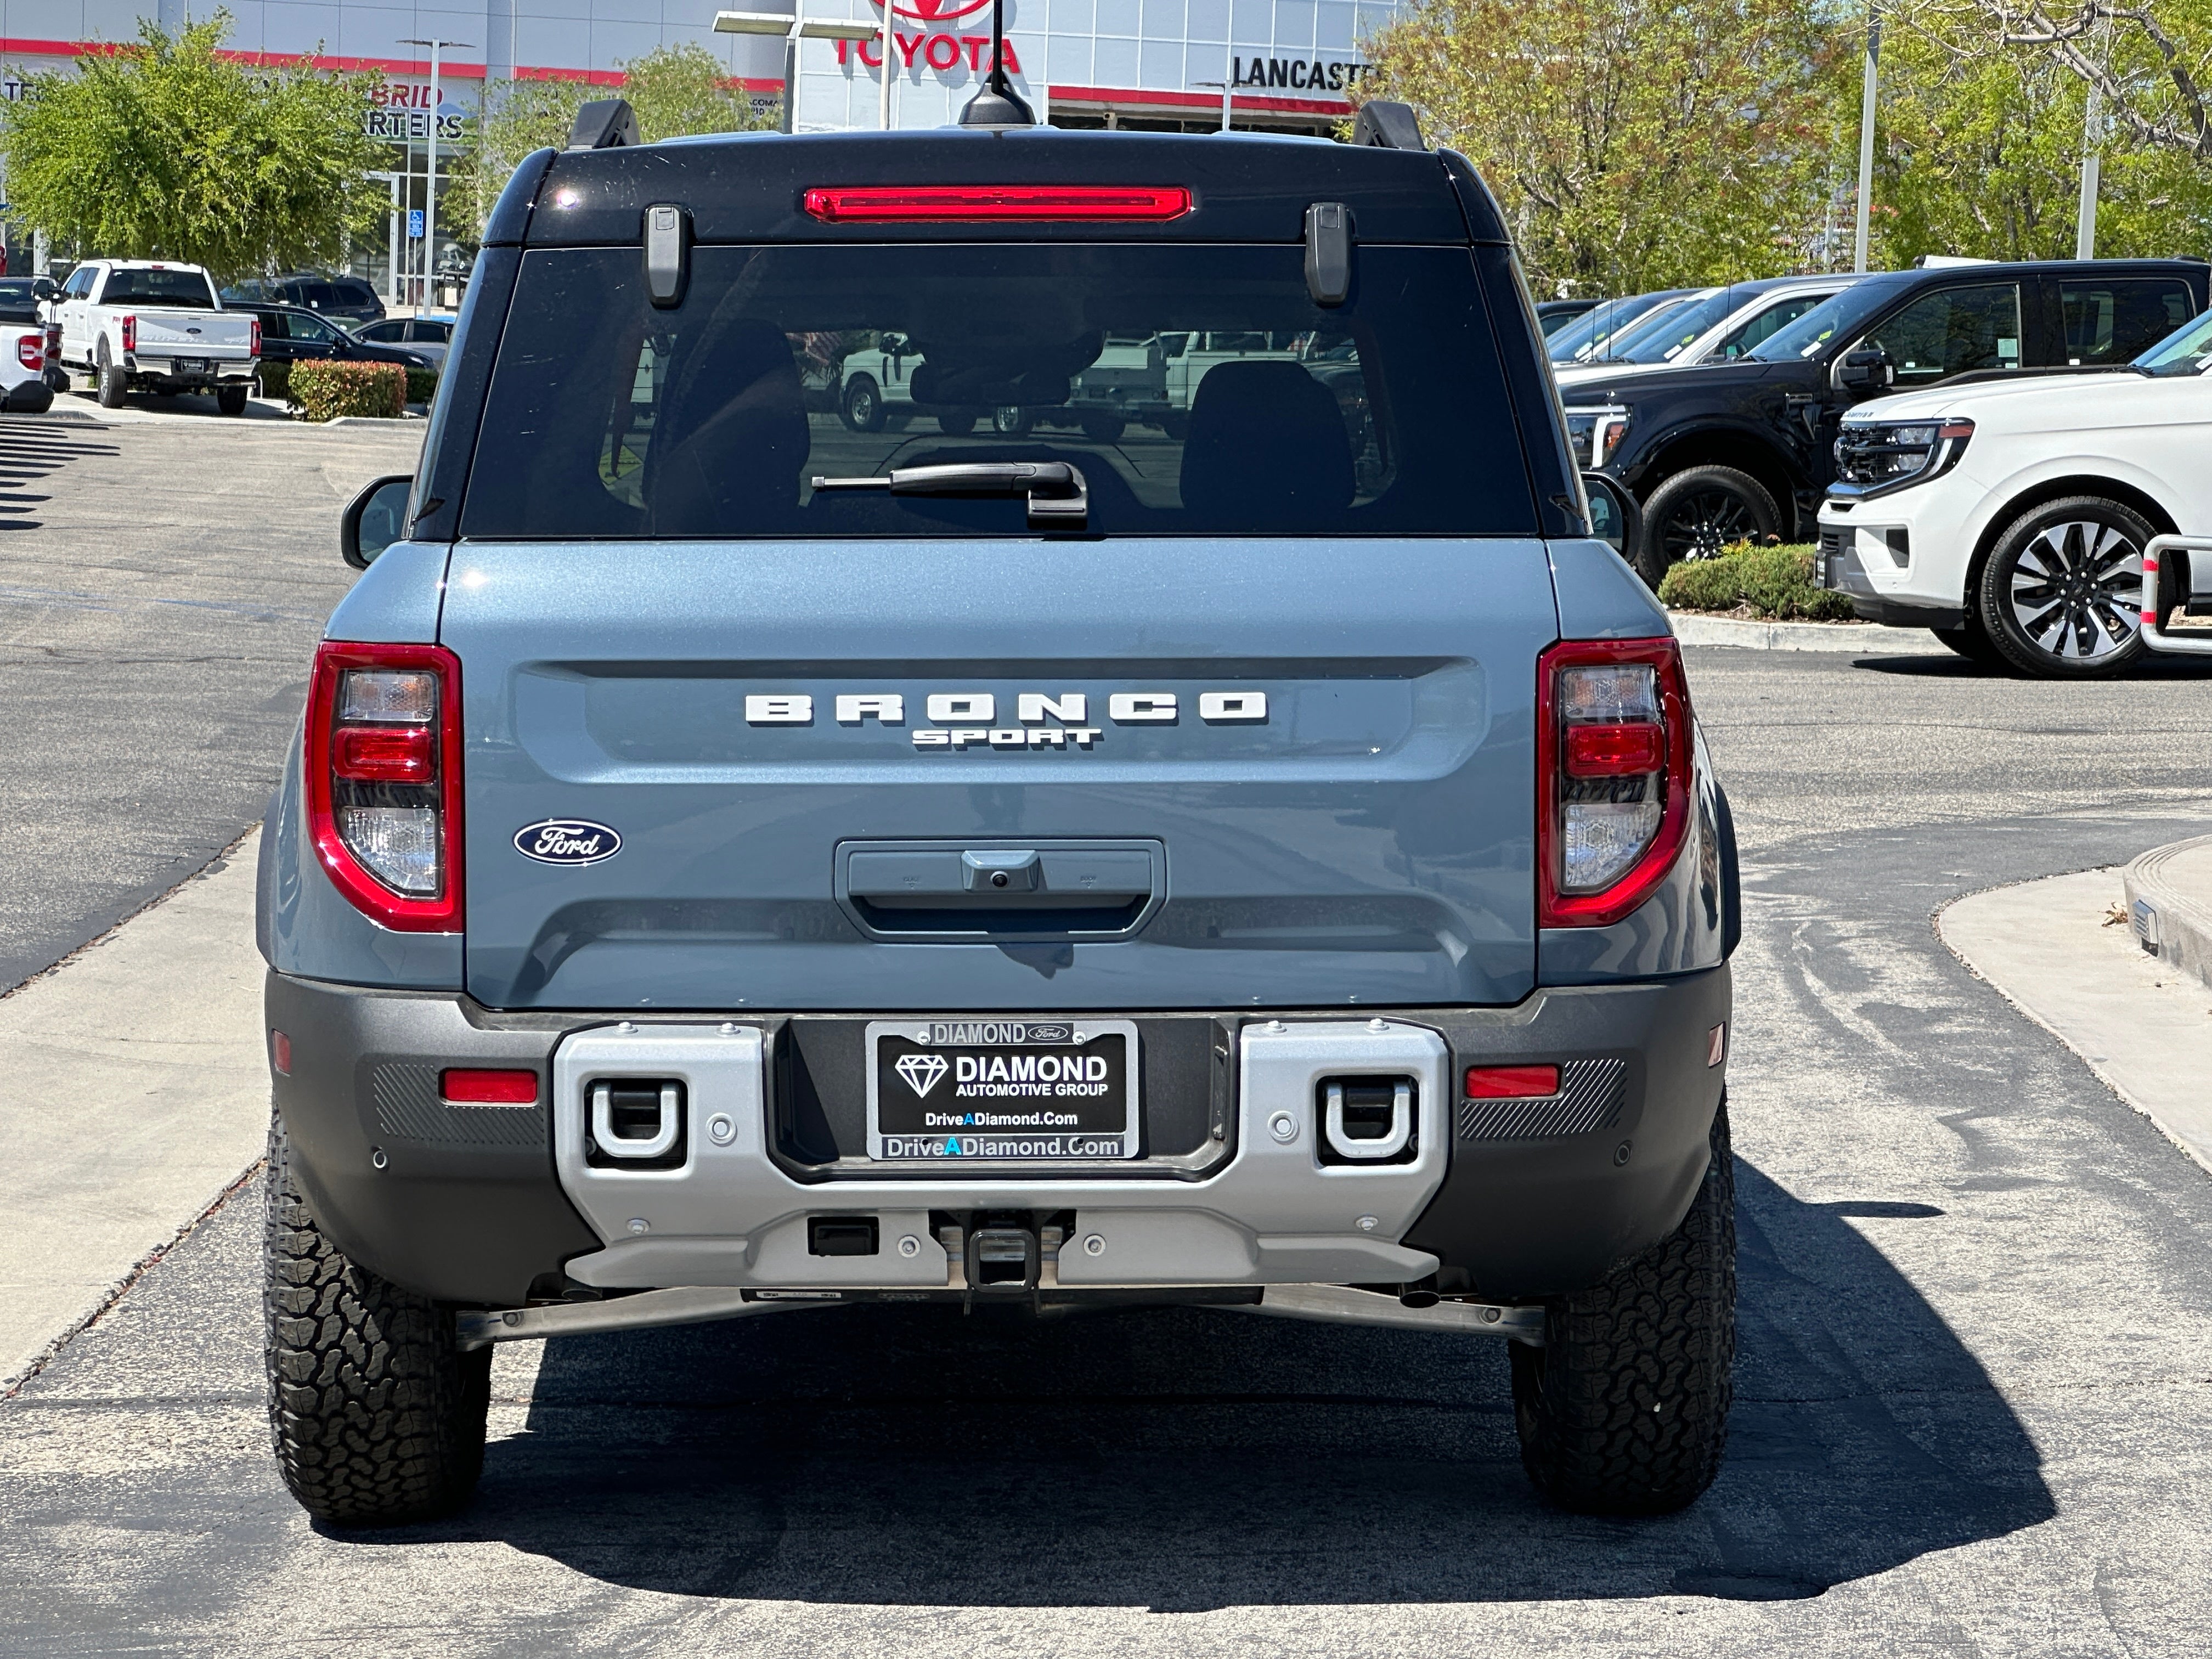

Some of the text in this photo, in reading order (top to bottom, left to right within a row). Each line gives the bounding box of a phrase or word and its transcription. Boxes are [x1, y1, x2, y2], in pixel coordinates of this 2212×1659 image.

[835, 31, 1020, 74] TOYOTA
[746, 692, 1266, 721] BRONCO
[912, 729, 1102, 744] SPORT
[535, 827, 600, 855] Ford
[934, 1024, 1061, 1043] DIAMOND Ford
[956, 1056, 1107, 1081] DIAMOND
[956, 1084, 1109, 1096] AUTOMOTIVE GROUP
[926, 1112, 1078, 1126] DriveADiamond.Com
[887, 1137, 1119, 1156] DriveADiamond.Com
